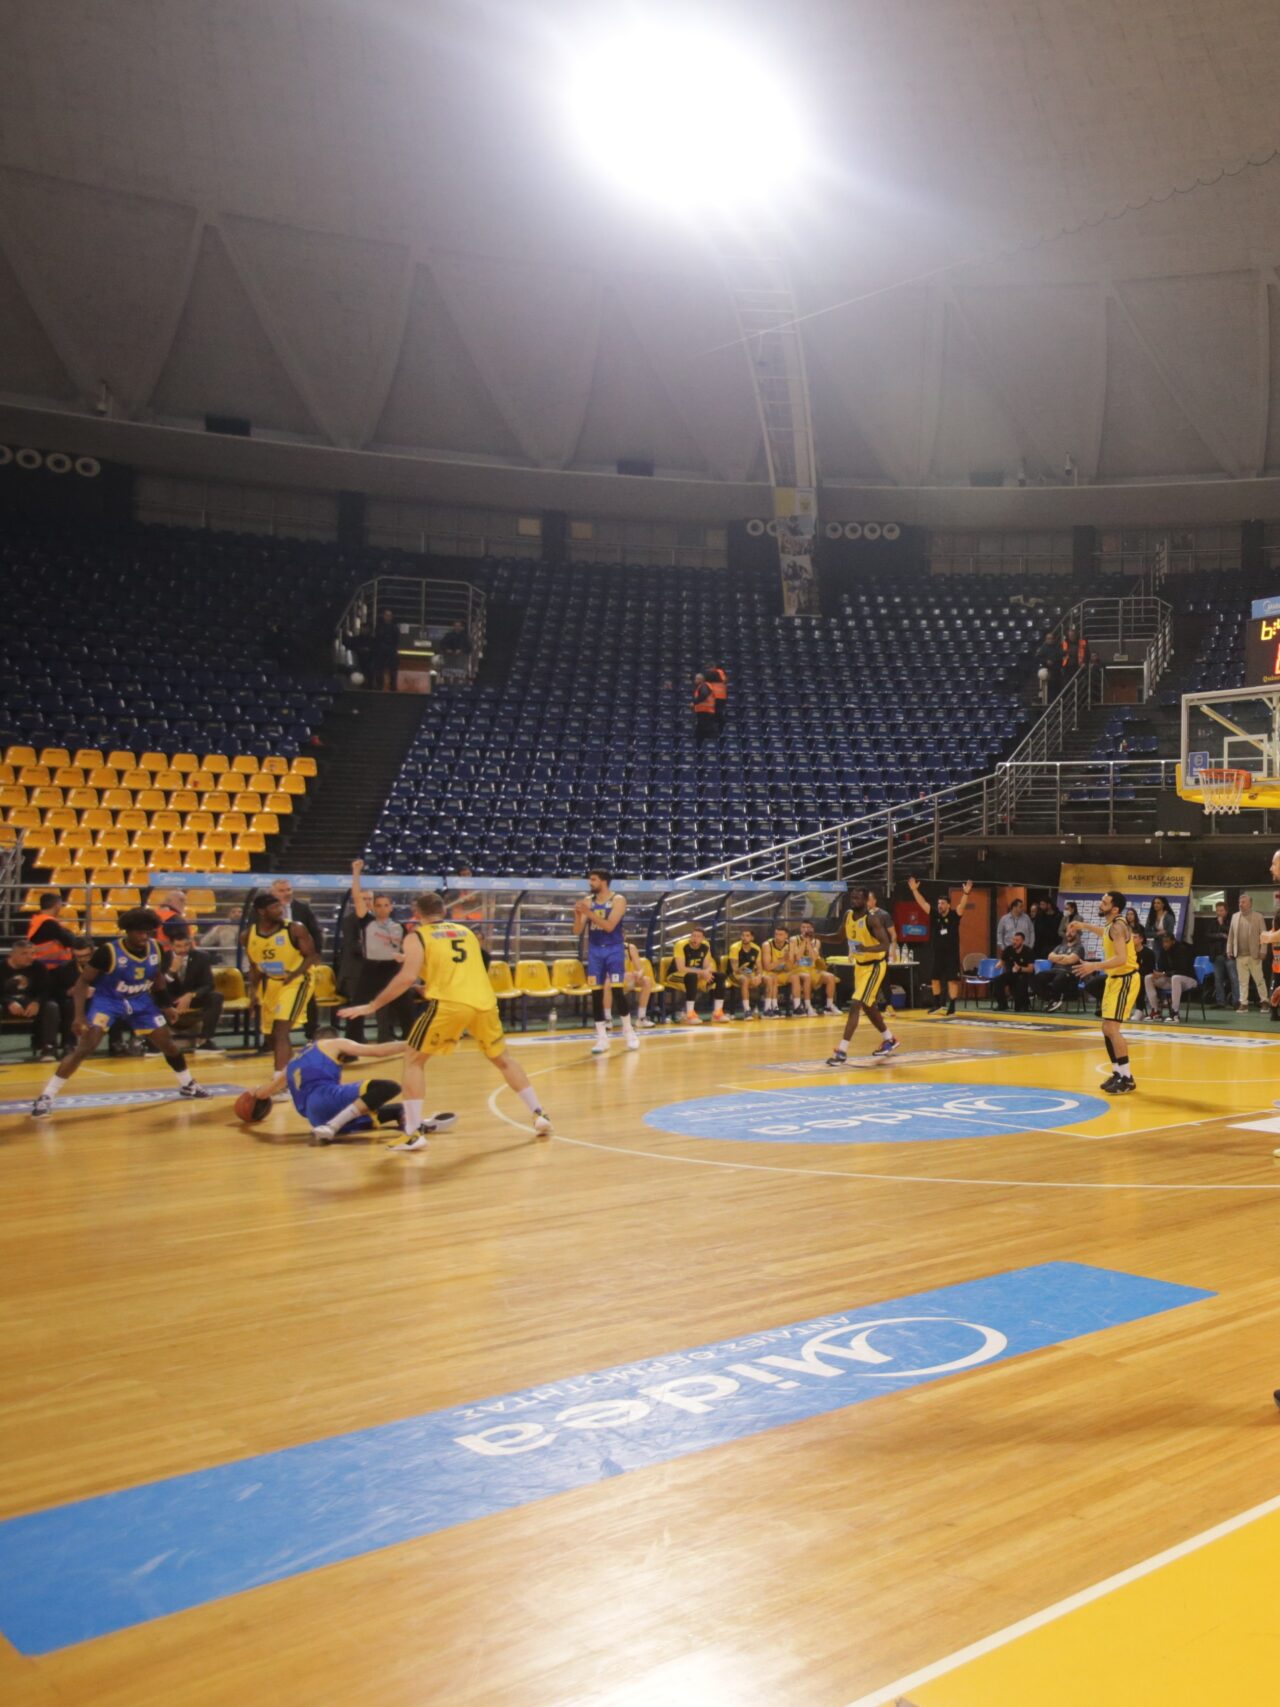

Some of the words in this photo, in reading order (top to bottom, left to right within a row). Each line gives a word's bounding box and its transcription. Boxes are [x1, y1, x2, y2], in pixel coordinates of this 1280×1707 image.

[262, 949, 275, 960] 55
[451, 939, 467, 963] 5
[134, 967, 146, 980] 3
[748, 1095, 1079, 1136] Midea
[453, 1316, 1008, 1456] Midea
